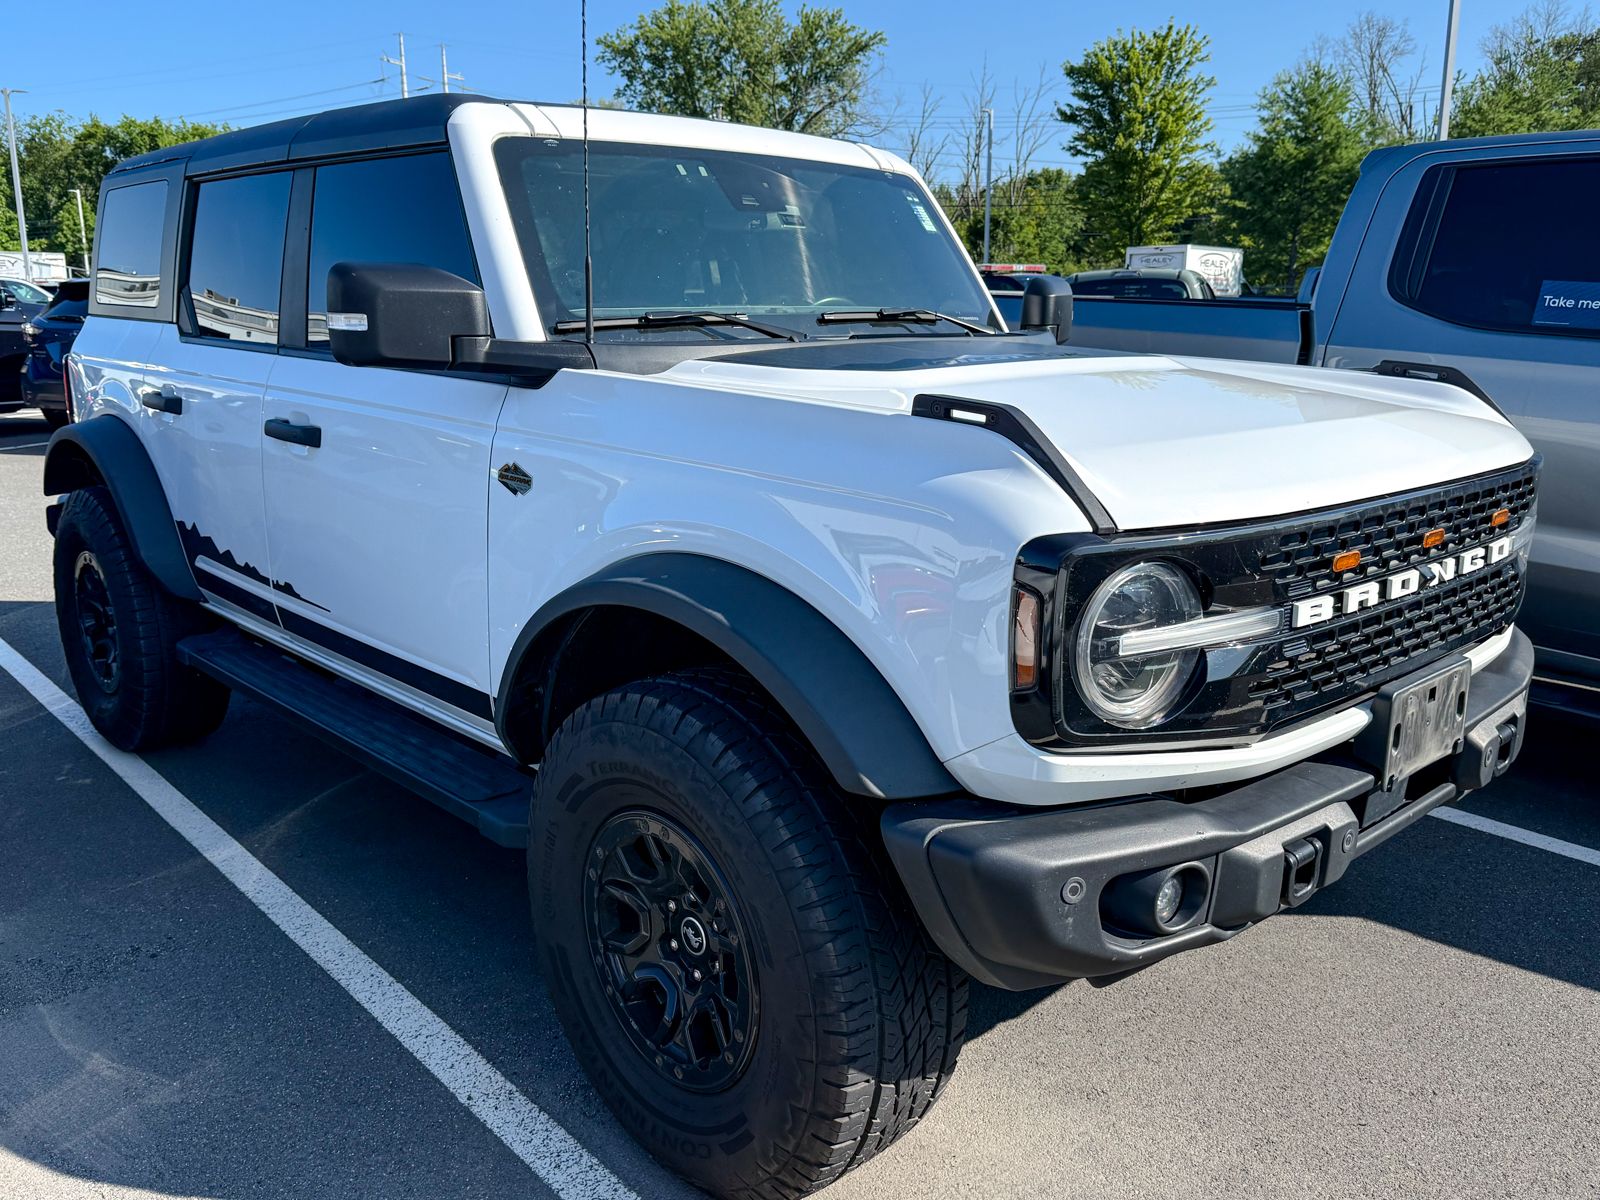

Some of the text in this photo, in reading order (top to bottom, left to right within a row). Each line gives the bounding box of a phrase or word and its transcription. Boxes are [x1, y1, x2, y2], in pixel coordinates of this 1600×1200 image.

[1140, 256, 1174, 264] HEALEY
[1200, 259, 1229, 269] HEALEY
[1543, 295, 1575, 307] Take
[1292, 535, 1514, 628] BRONCO
